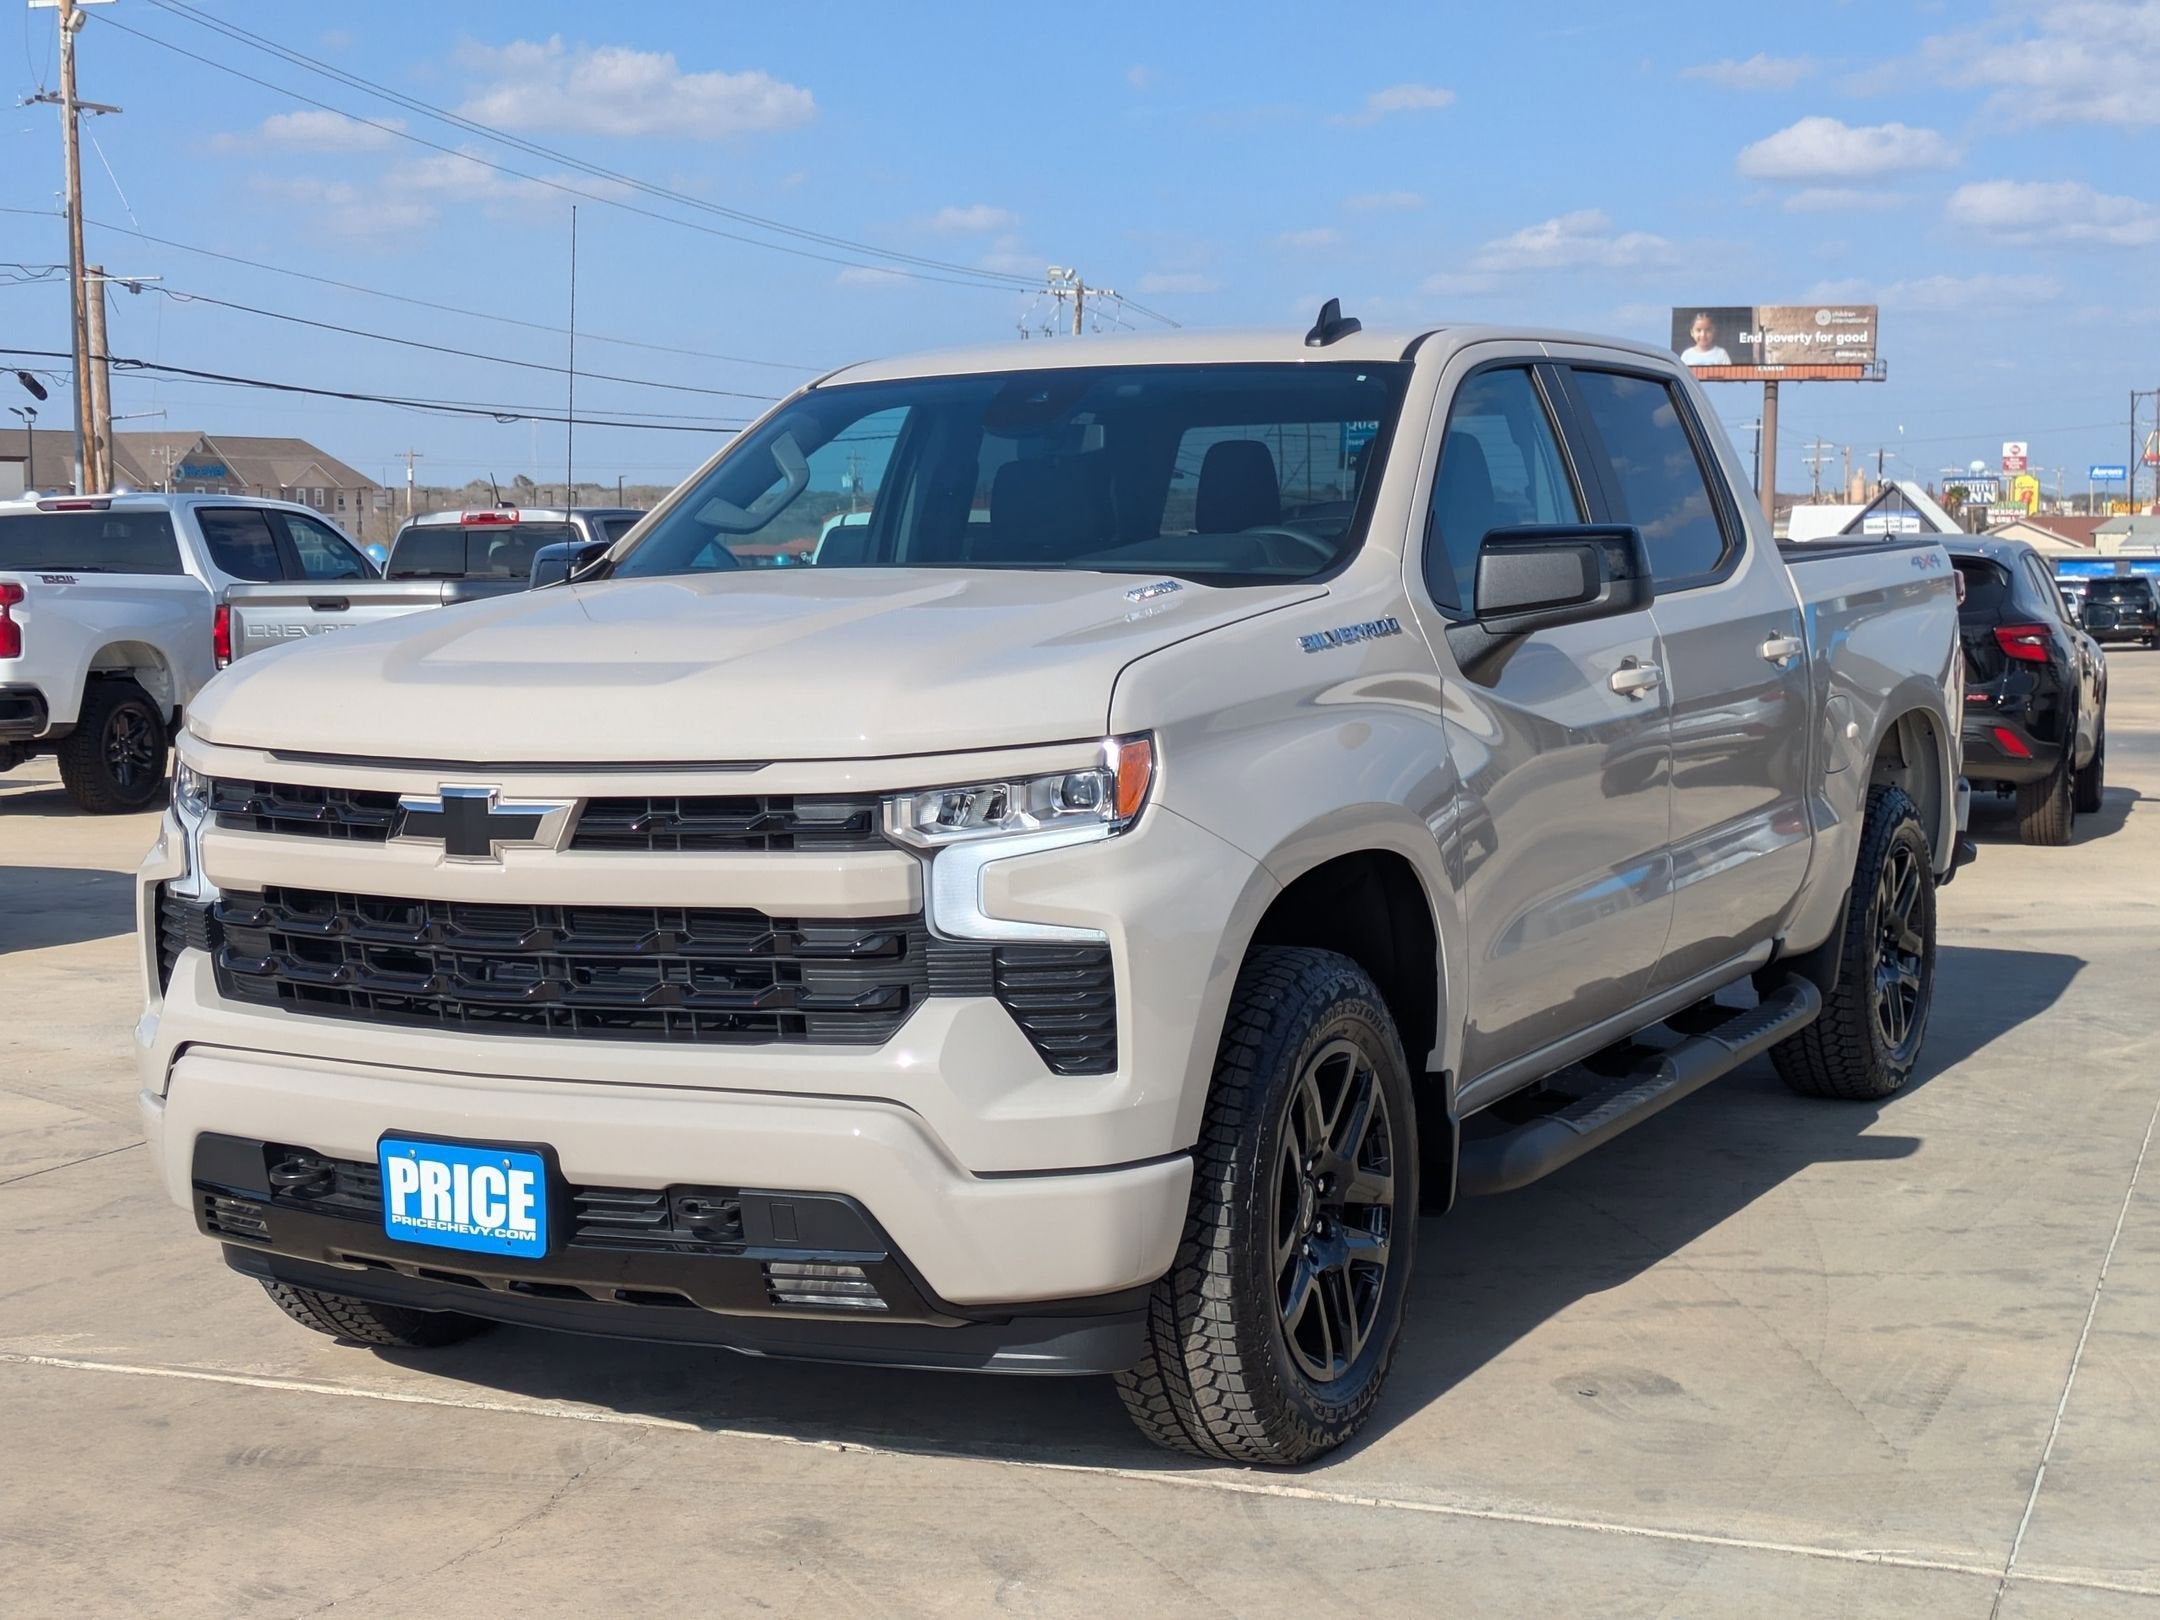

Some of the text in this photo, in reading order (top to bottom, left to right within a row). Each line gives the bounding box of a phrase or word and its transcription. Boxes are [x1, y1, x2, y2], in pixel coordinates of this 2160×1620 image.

[1739, 331, 1868, 346] End poverty for good
[387, 1156, 536, 1232] PRICE
[391, 1214, 537, 1242] PRICECHEVY.COM
